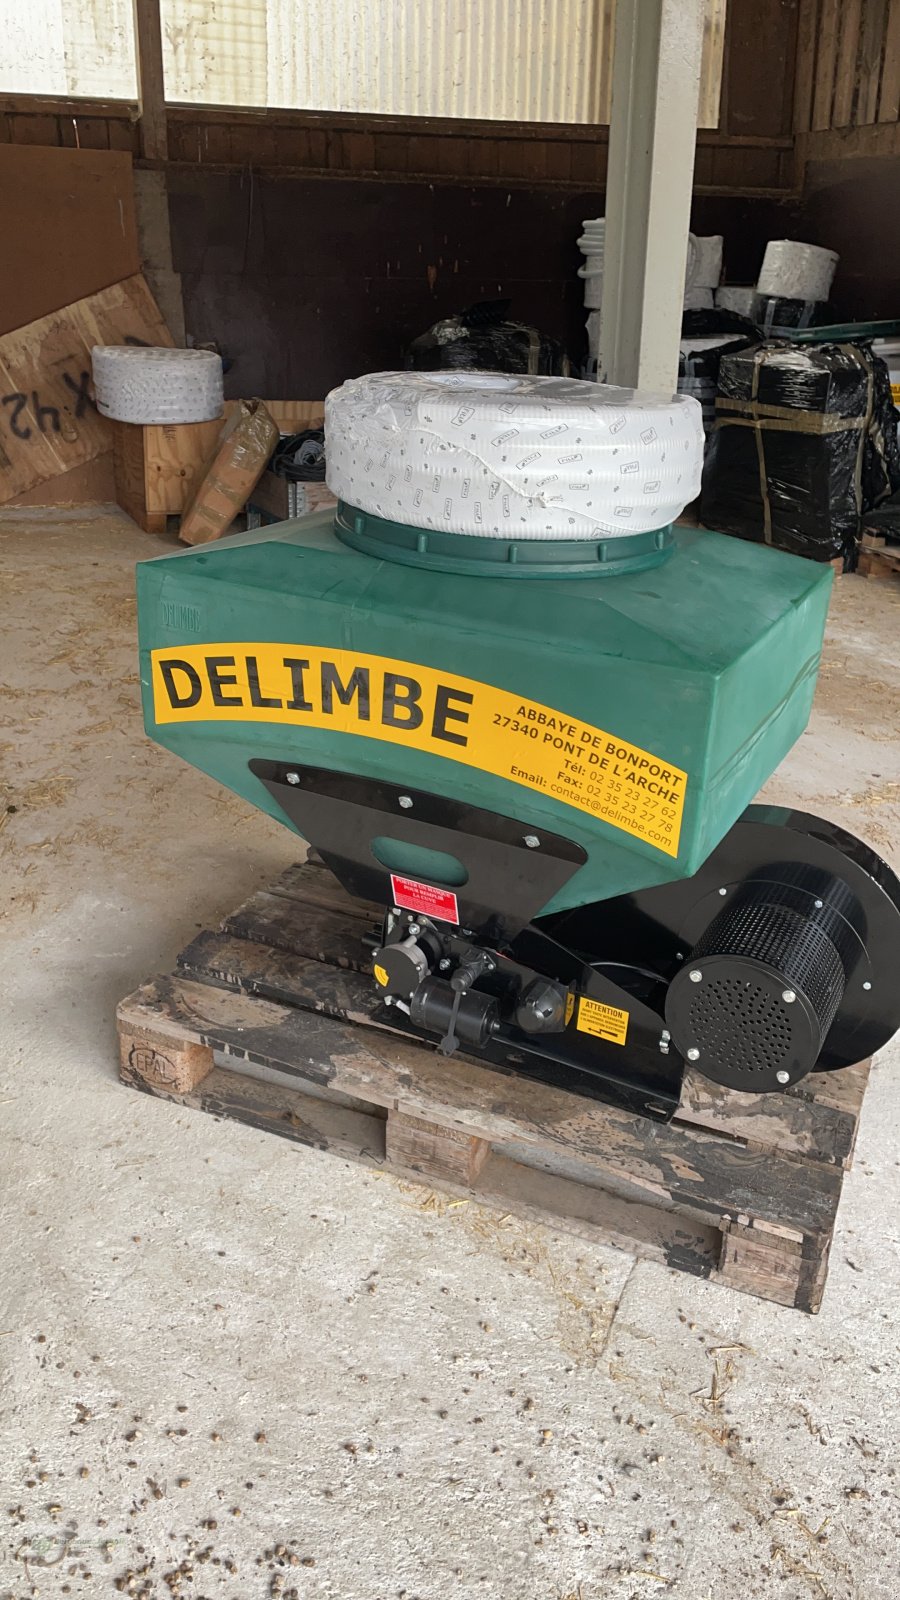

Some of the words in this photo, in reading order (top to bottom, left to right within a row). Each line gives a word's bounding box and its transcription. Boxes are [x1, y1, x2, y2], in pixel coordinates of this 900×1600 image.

[159, 656, 474, 747] DELIMBE
[492, 713, 538, 739] 27340
[543, 732, 585, 759] PONT
[588, 752, 608, 770] DE
[612, 763, 680, 804] L'ARCHE
[516, 705, 577, 738] ABBAYE
[580, 730, 602, 749] DE
[605, 742, 682, 787] BONPORT
[510, 765, 547, 787] Email:
[550, 782, 672, 847] contact@delimbe.com
[557, 771, 582, 789] Fax:
[586, 784, 601, 798] 02
[603, 791, 619, 805] 35
[622, 800, 636, 814] 23
[639, 808, 655, 823] 27
[658, 818, 673, 833] 78
[563, 759, 586, 776] Tél:
[589, 770, 605, 784] 02
[607, 778, 622, 793] 35
[625, 787, 640, 801] 23
[642, 796, 658, 810] 27
[661, 805, 676, 820] 62
[585, 1001, 623, 1019] ATTENTION
